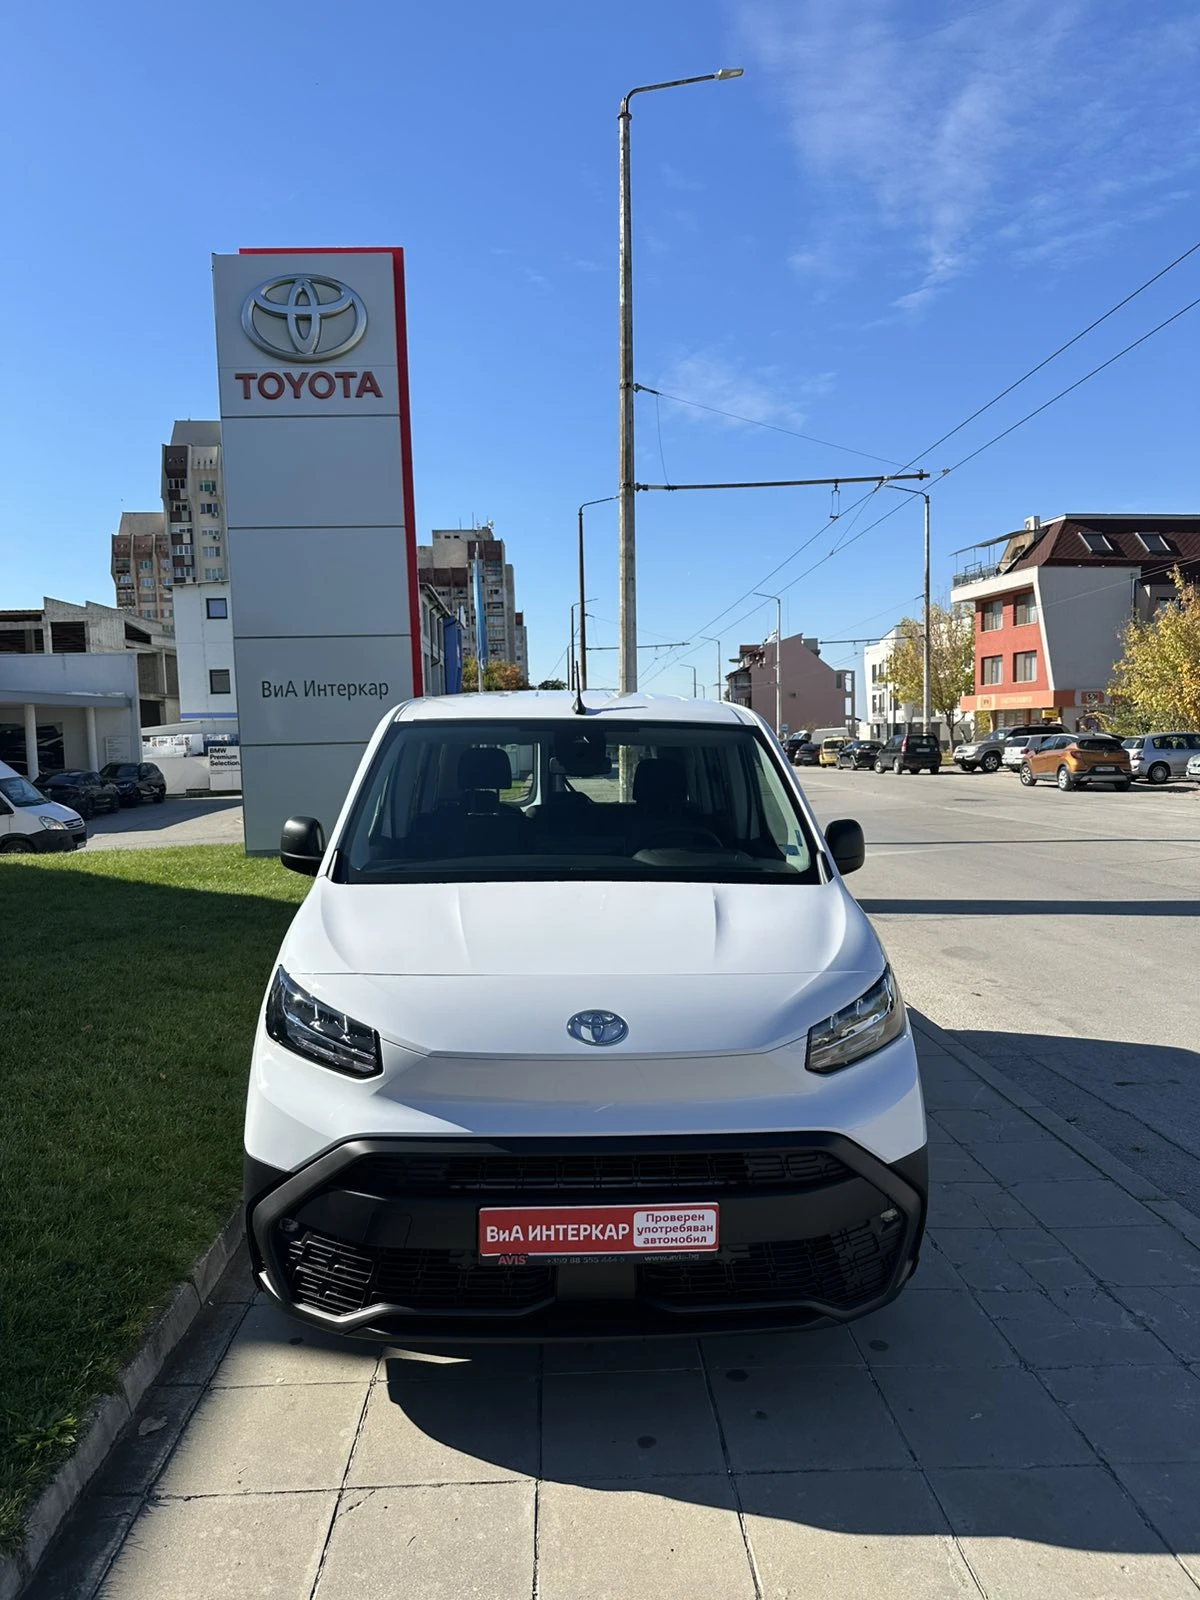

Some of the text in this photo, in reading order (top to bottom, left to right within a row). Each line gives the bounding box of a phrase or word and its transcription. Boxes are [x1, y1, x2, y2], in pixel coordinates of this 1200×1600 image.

[235, 371, 383, 400] TOYOTA
[261, 680, 389, 700] ВиА Интеркар
[646, 1213, 705, 1226] Проверен
[486, 1223, 630, 1242] ВиА ИНТЕРКАР
[637, 1223, 714, 1237] употребяван
[643, 1233, 707, 1245] автомобил
[498, 1255, 526, 1265] AVIS
